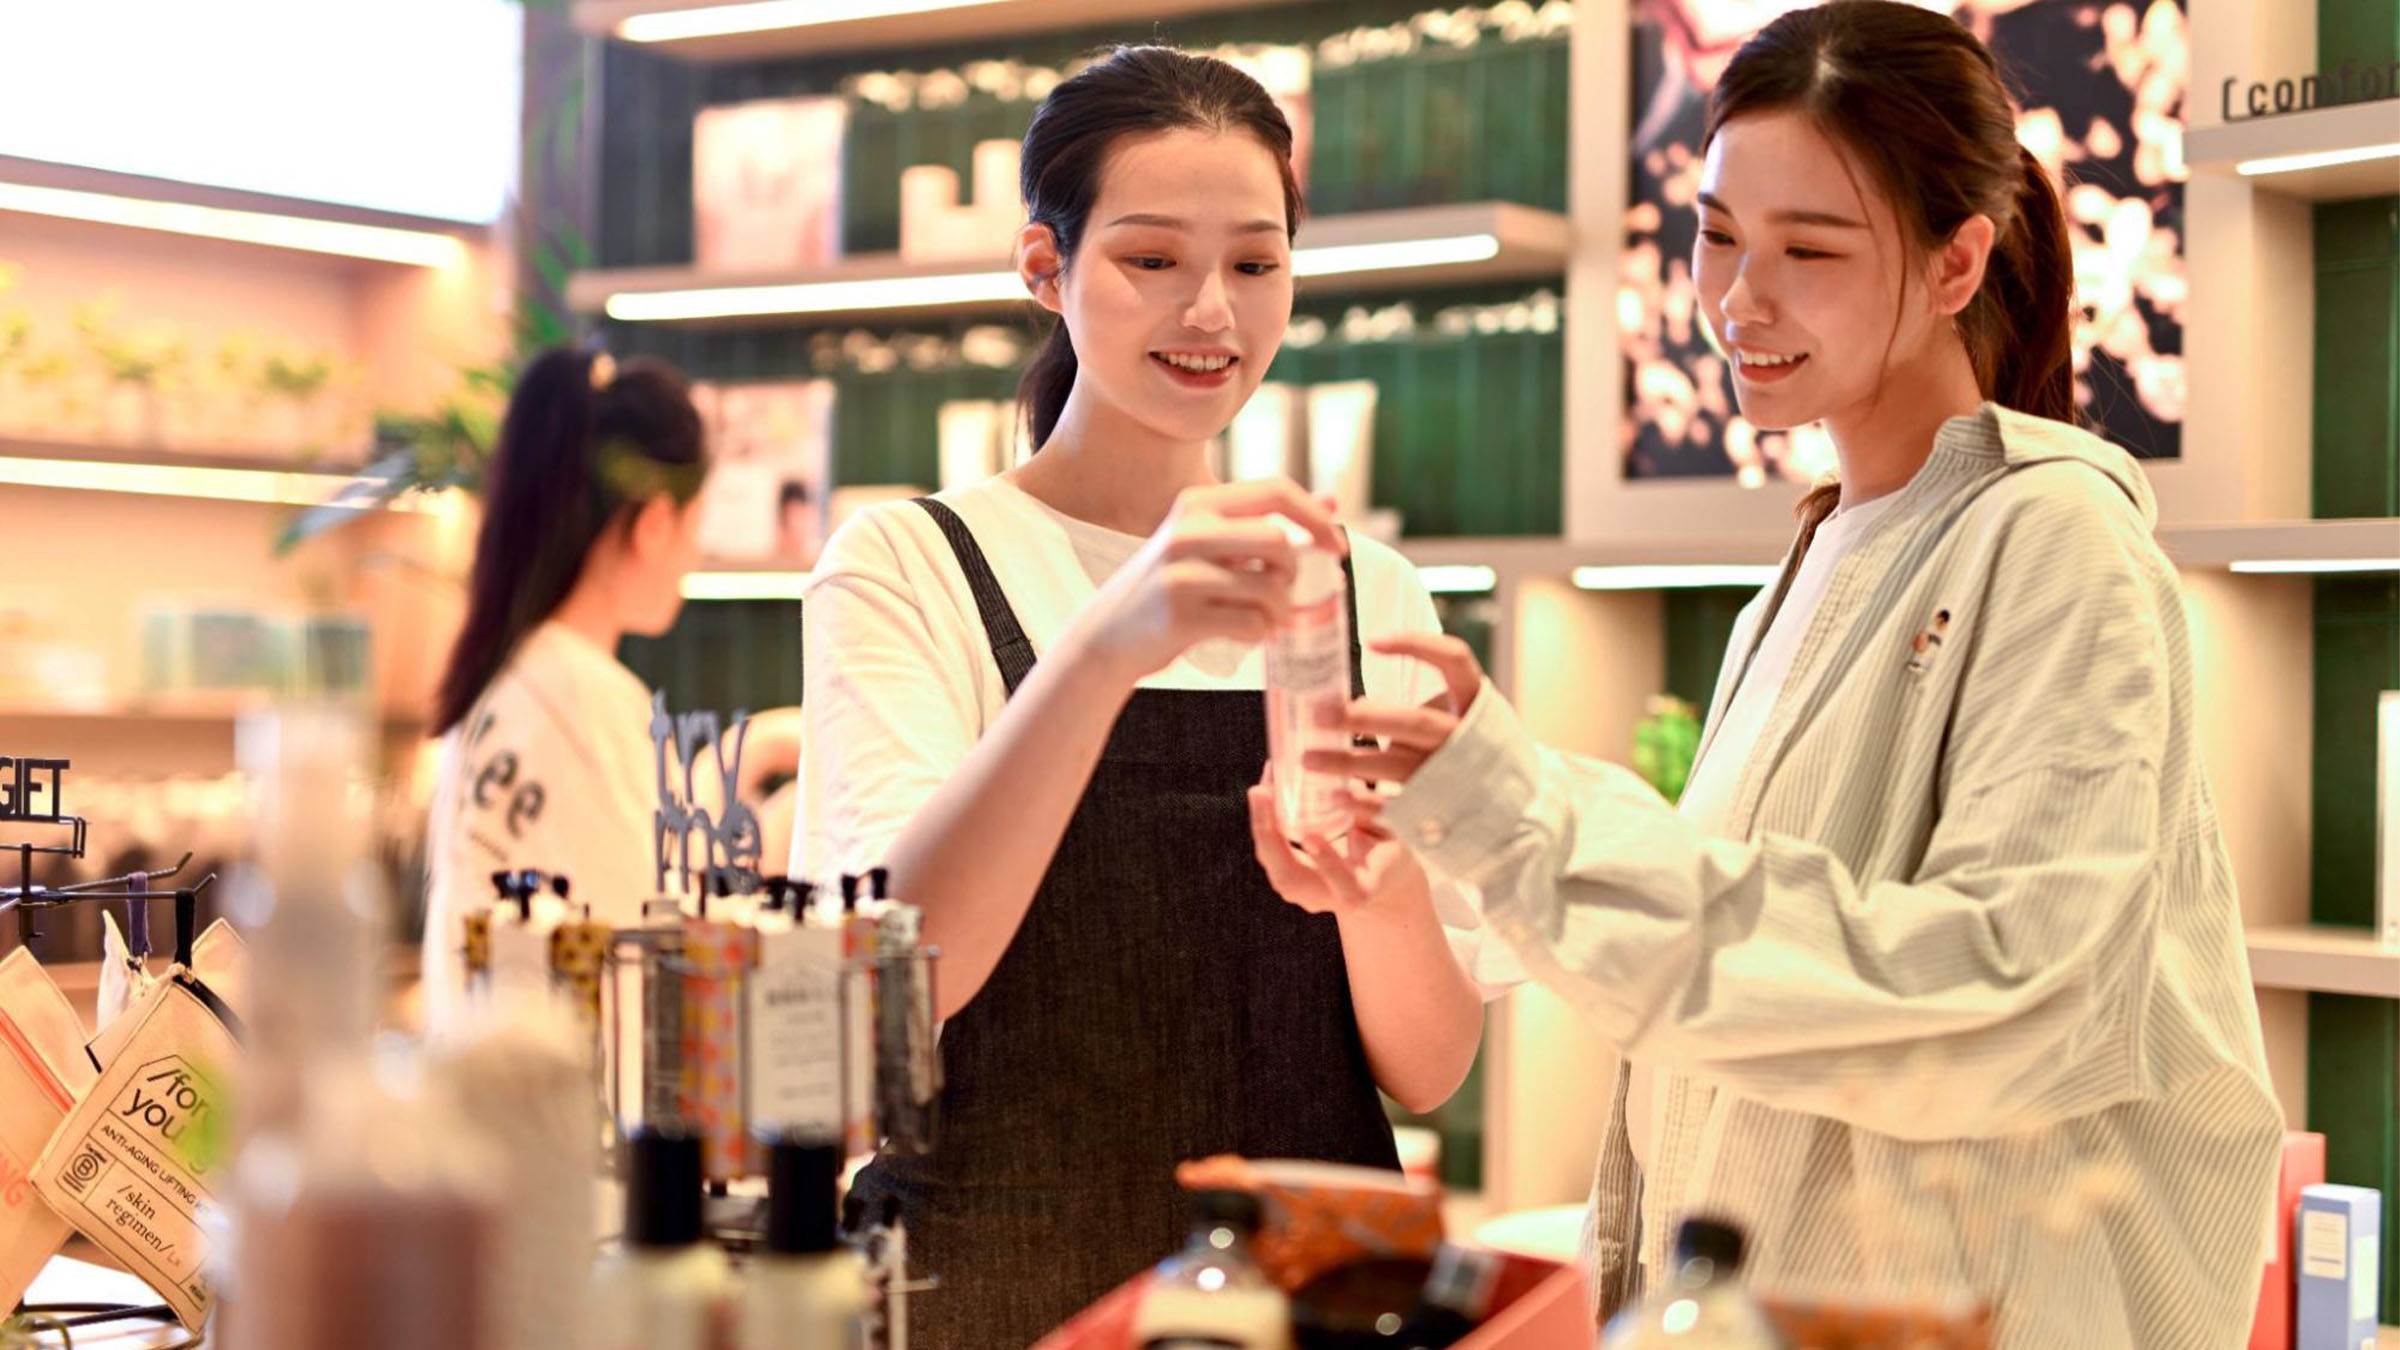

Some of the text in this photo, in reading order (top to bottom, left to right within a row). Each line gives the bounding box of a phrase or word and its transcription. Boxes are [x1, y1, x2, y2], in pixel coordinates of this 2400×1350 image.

[0, 757, 70, 823] GIFT
[102, 1125, 160, 1174] ANTI-AGING
[158, 1170, 197, 1205] LIFTING
